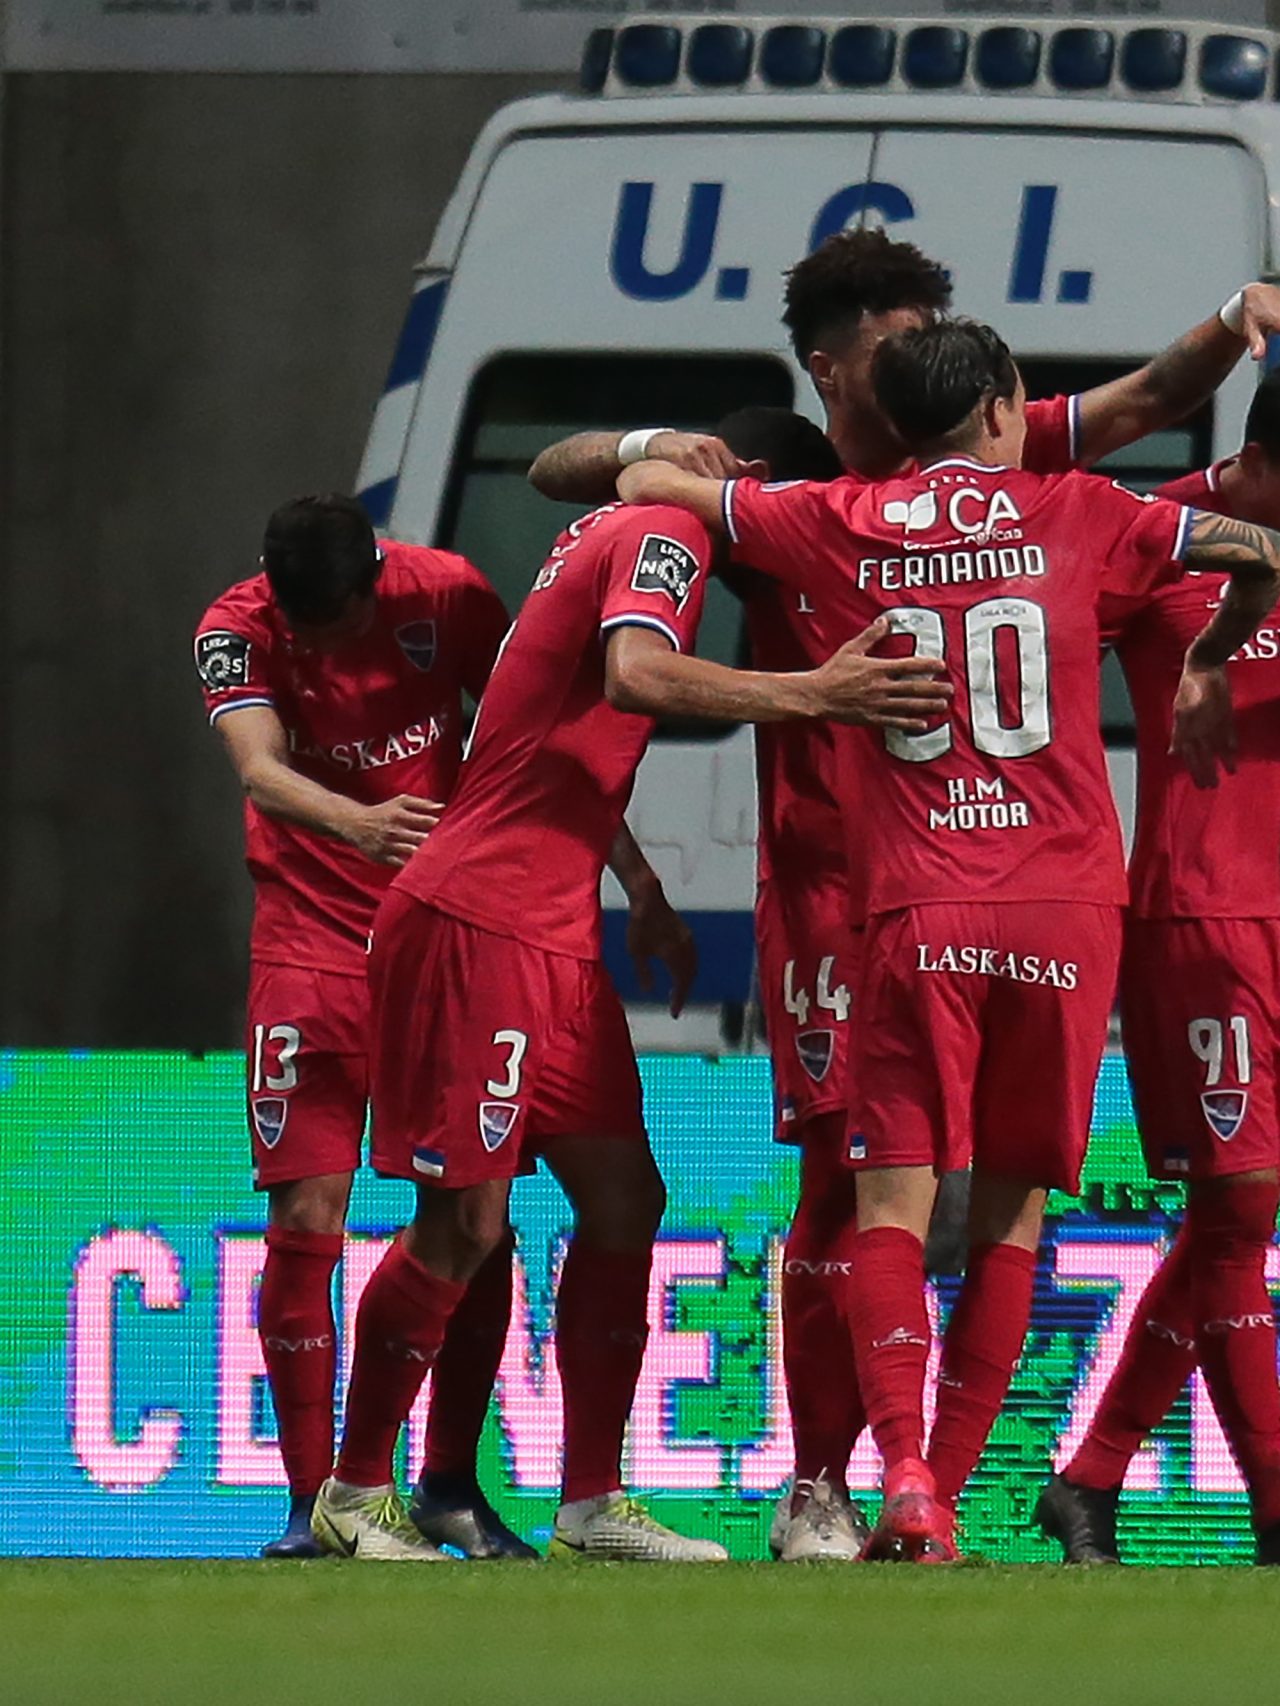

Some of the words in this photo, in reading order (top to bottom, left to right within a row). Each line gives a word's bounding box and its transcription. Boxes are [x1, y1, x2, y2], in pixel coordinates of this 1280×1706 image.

[949, 487, 1021, 535] CA
[659, 543, 688, 568] LIGA
[857, 545, 1046, 590] FERNANDO
[881, 597, 1052, 764] 20
[948, 776, 1004, 803] H.M
[929, 802, 1029, 832] MOTOR
[783, 955, 852, 1026] 44
[916, 943, 1079, 991] LASKASAS
[252, 1023, 301, 1092] 13
[486, 1029, 528, 1099] 3
[1188, 1015, 1251, 1086] 91
